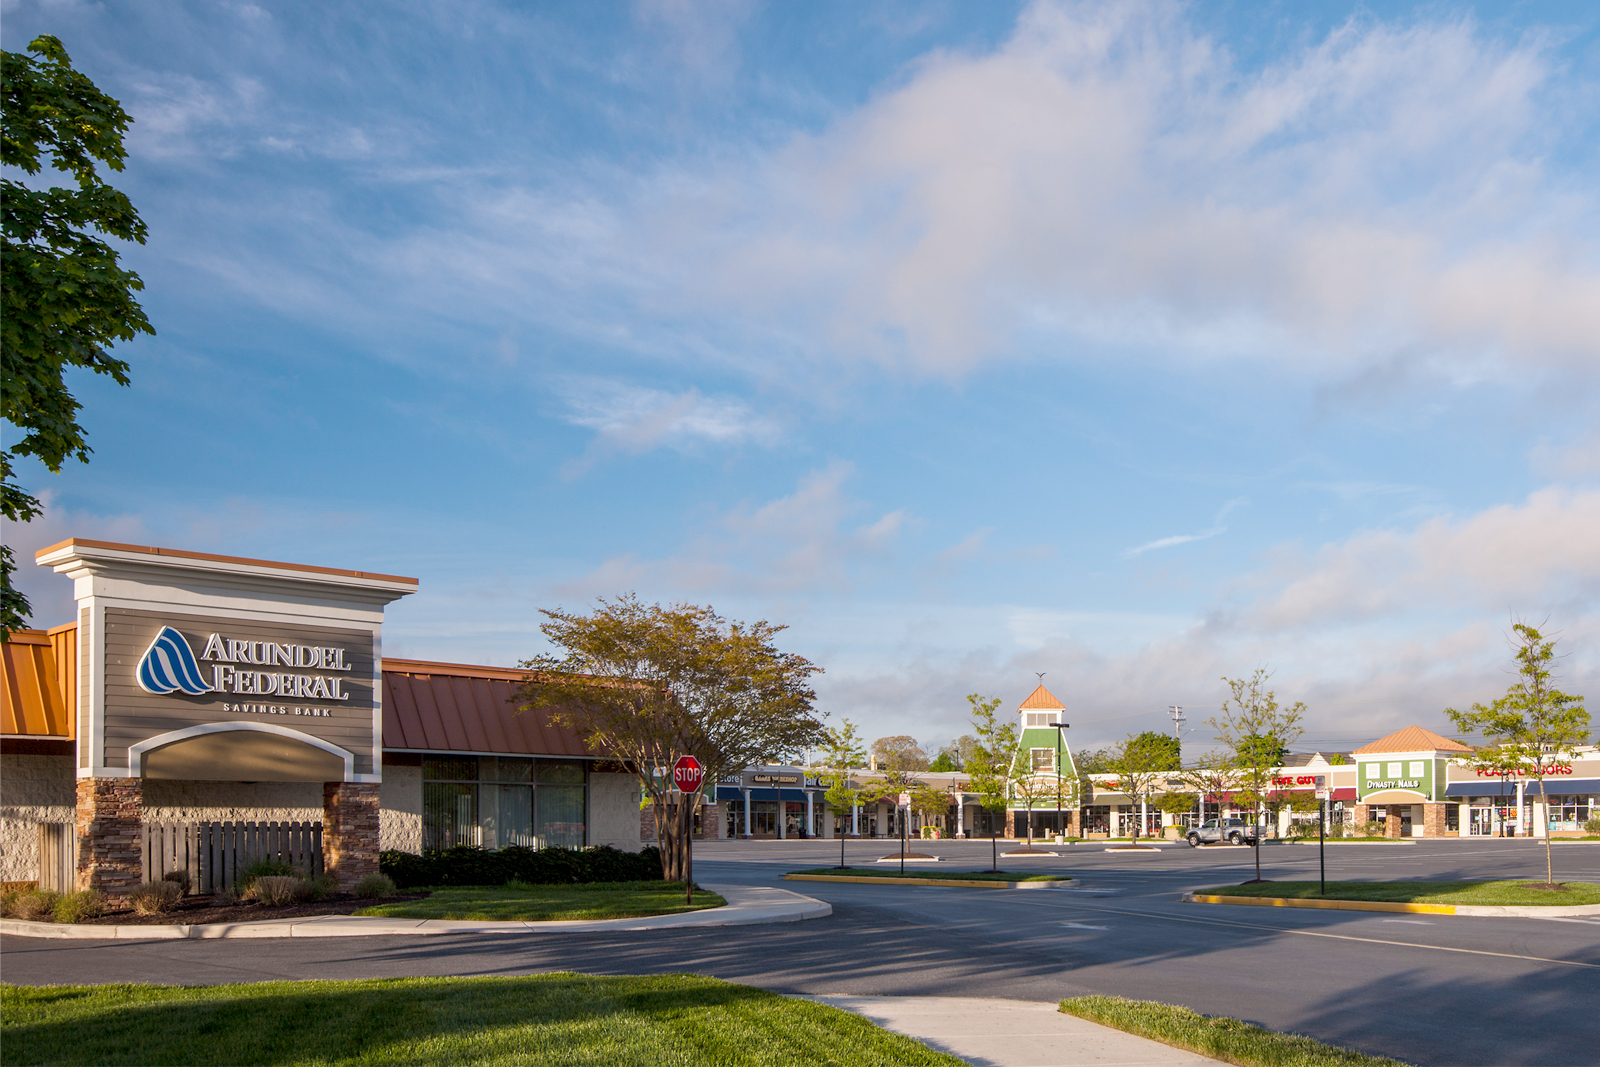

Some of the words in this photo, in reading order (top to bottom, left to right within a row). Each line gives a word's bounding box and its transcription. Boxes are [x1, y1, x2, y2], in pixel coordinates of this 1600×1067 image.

[201, 633, 352, 671] ARUNDEL
[212, 664, 350, 700] FEDERAL
[223, 703, 287, 715] SAVINGS
[295, 707, 331, 717] BANK
[675, 767, 700, 782] STOP
[1296, 775, 1316, 785] GUY
[1366, 781, 1396, 789] DYNASTY
[1398, 779, 1420, 788] NAILS
